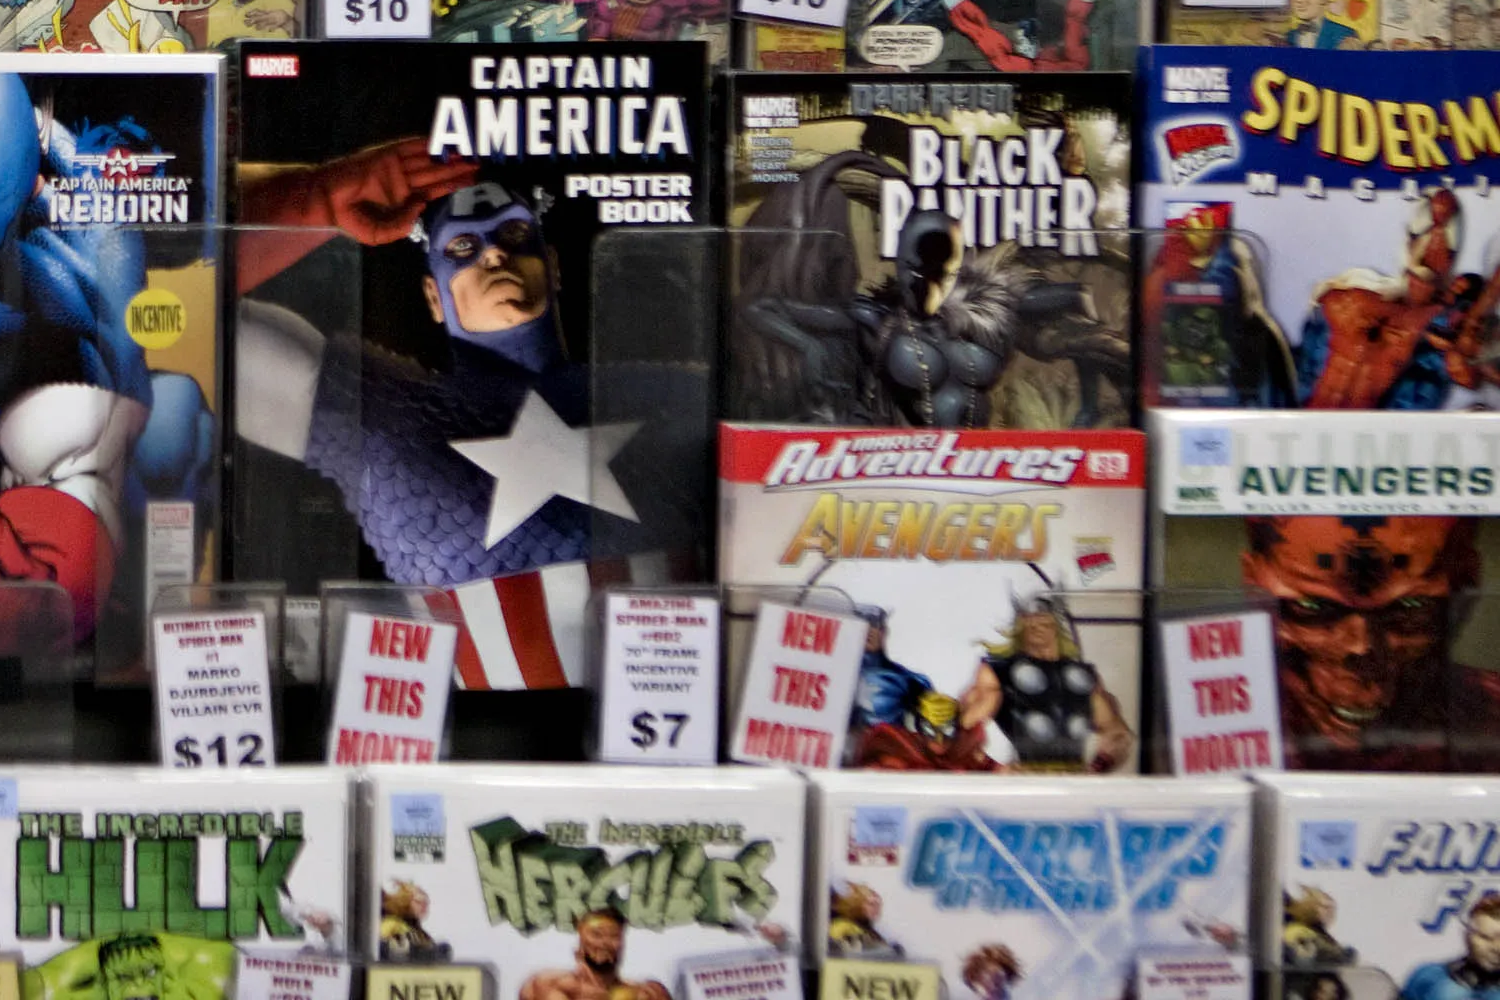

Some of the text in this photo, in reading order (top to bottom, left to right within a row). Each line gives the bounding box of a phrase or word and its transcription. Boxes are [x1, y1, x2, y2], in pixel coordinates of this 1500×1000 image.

[248, 57, 297, 76] MARVEL
[471, 56, 651, 89] CAPTAIN
[429, 96, 690, 157] AMERICA
[909, 126, 1064, 187] BLACK
[51, 177, 188, 192] CAPTAIN AMERICA
[566, 175, 692, 198] POSTER
[50, 195, 188, 223] REBORN
[600, 202, 693, 223] BOOK
[131, 304, 182, 333] INCENTIVE
[765, 432, 1086, 483] Adventures
[1238, 466, 1495, 497] AVENGERS
[780, 492, 1064, 565] AVENGERS
[630, 710, 690, 750] $7
[175, 734, 265, 767] $12
[17, 837, 304, 939] HULK
